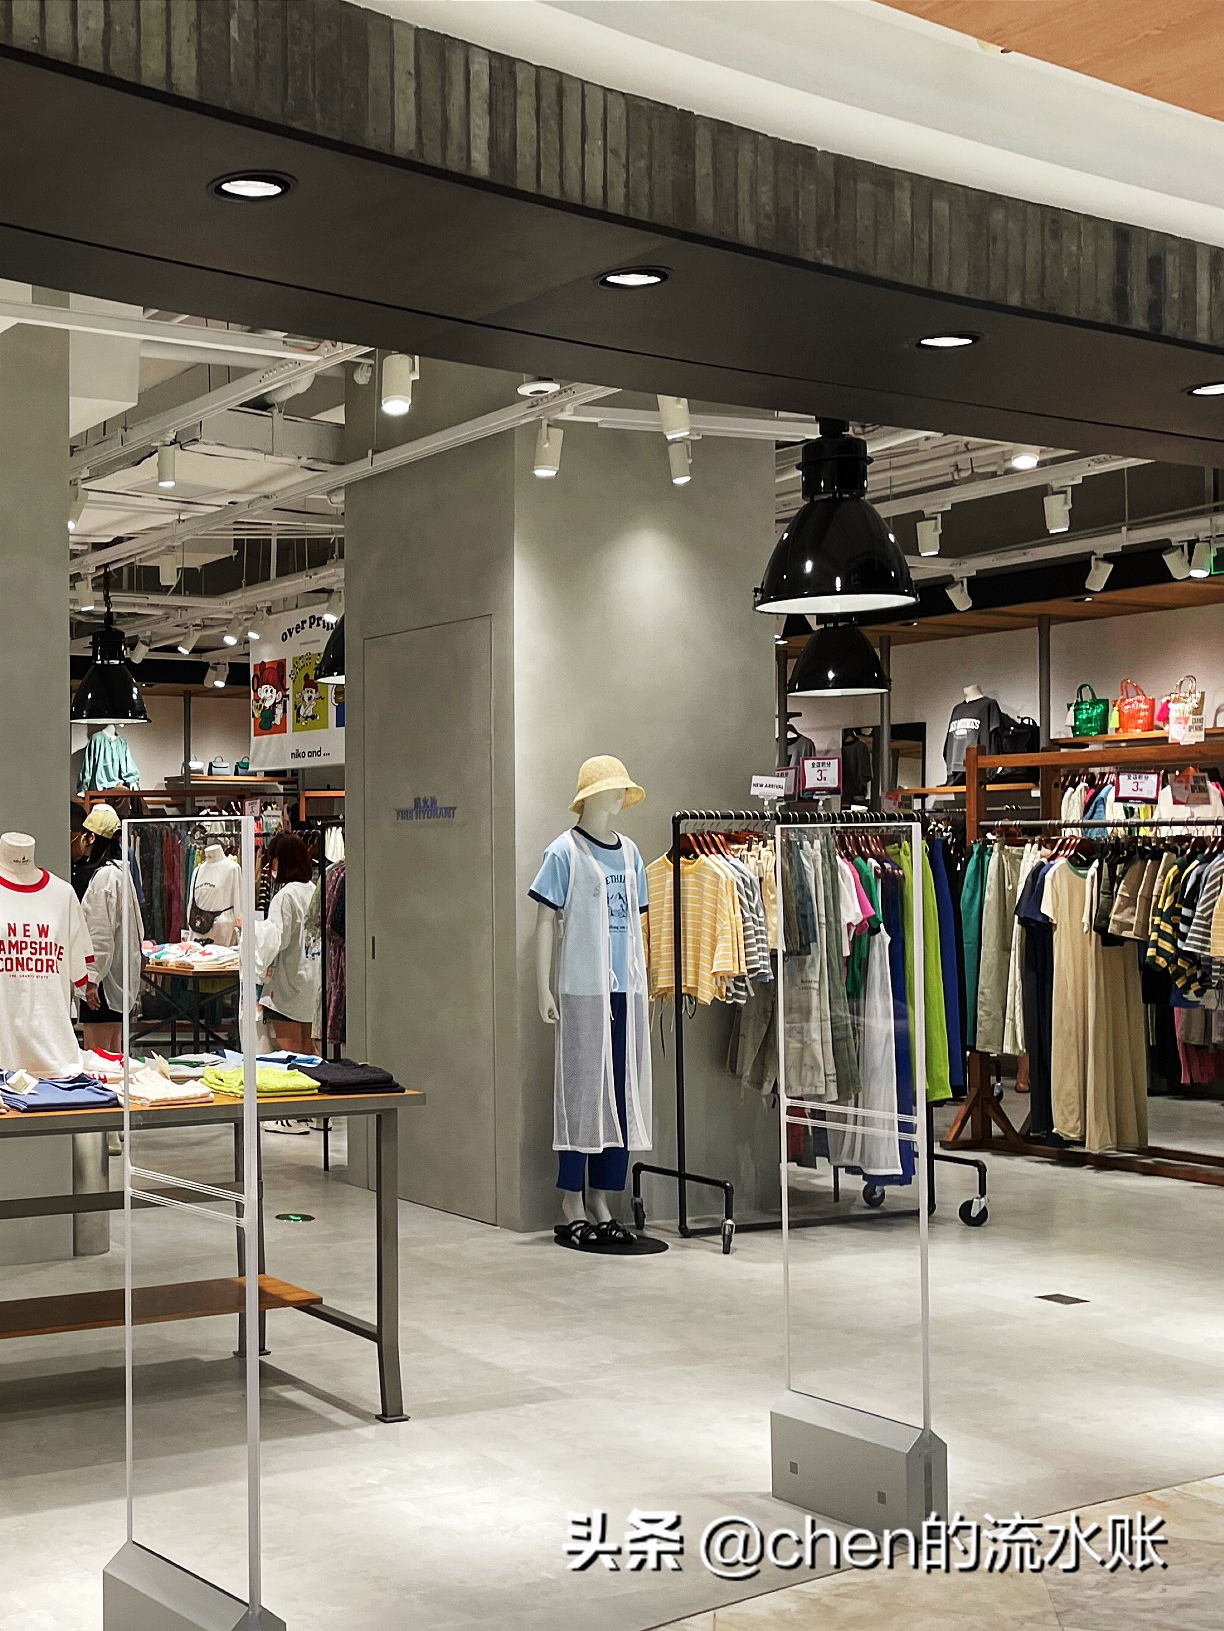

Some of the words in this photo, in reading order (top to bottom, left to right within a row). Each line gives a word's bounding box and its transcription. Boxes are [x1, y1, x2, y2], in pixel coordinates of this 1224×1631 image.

[281, 619, 306, 643] over
[291, 749, 306, 759] niko
[308, 747, 322, 759] and
[7, 922, 49, 938] NEW
